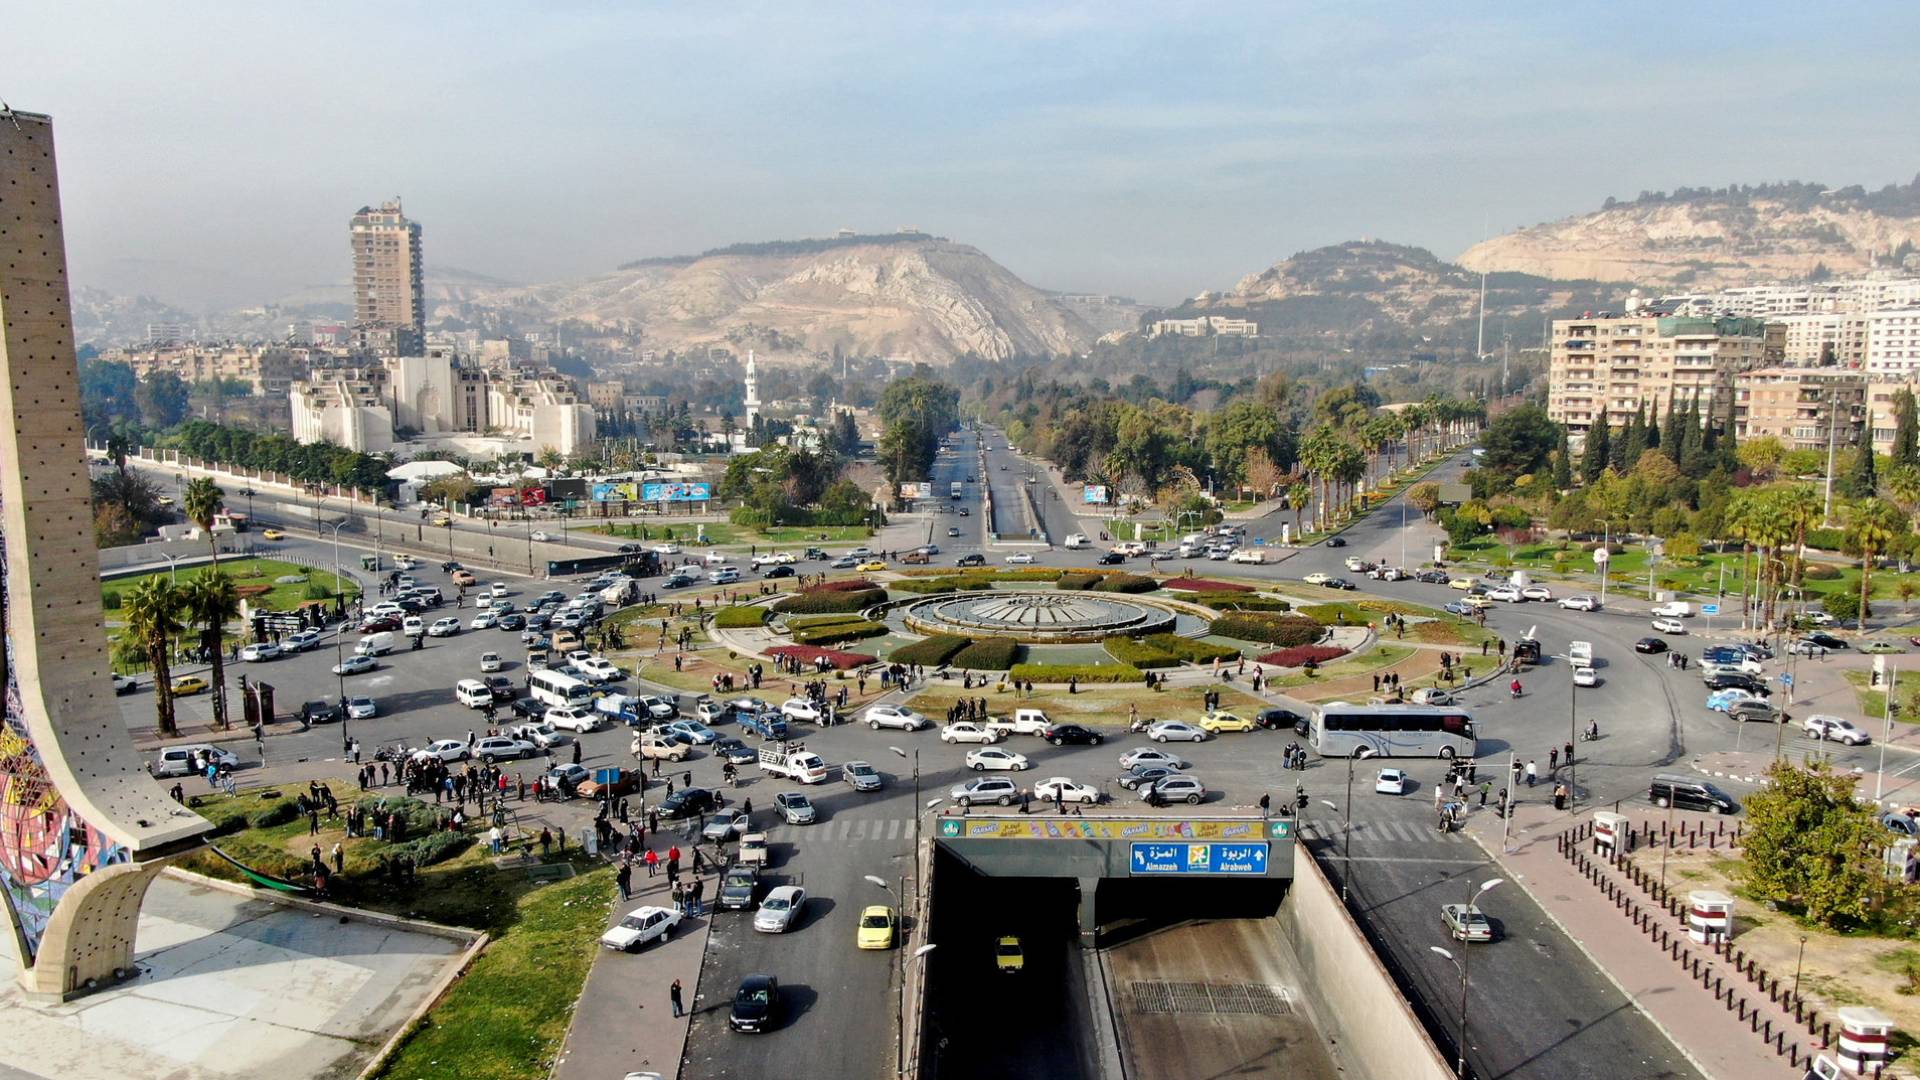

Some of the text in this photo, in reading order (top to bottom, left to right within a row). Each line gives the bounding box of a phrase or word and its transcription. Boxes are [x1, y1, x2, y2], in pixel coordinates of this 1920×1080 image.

[1149, 846, 1177, 860] المزة
[1222, 846, 1251, 860] الربوة
[1145, 862, 1178, 872] Almazzeh
[1220, 862, 1253, 872] Alrabweh
